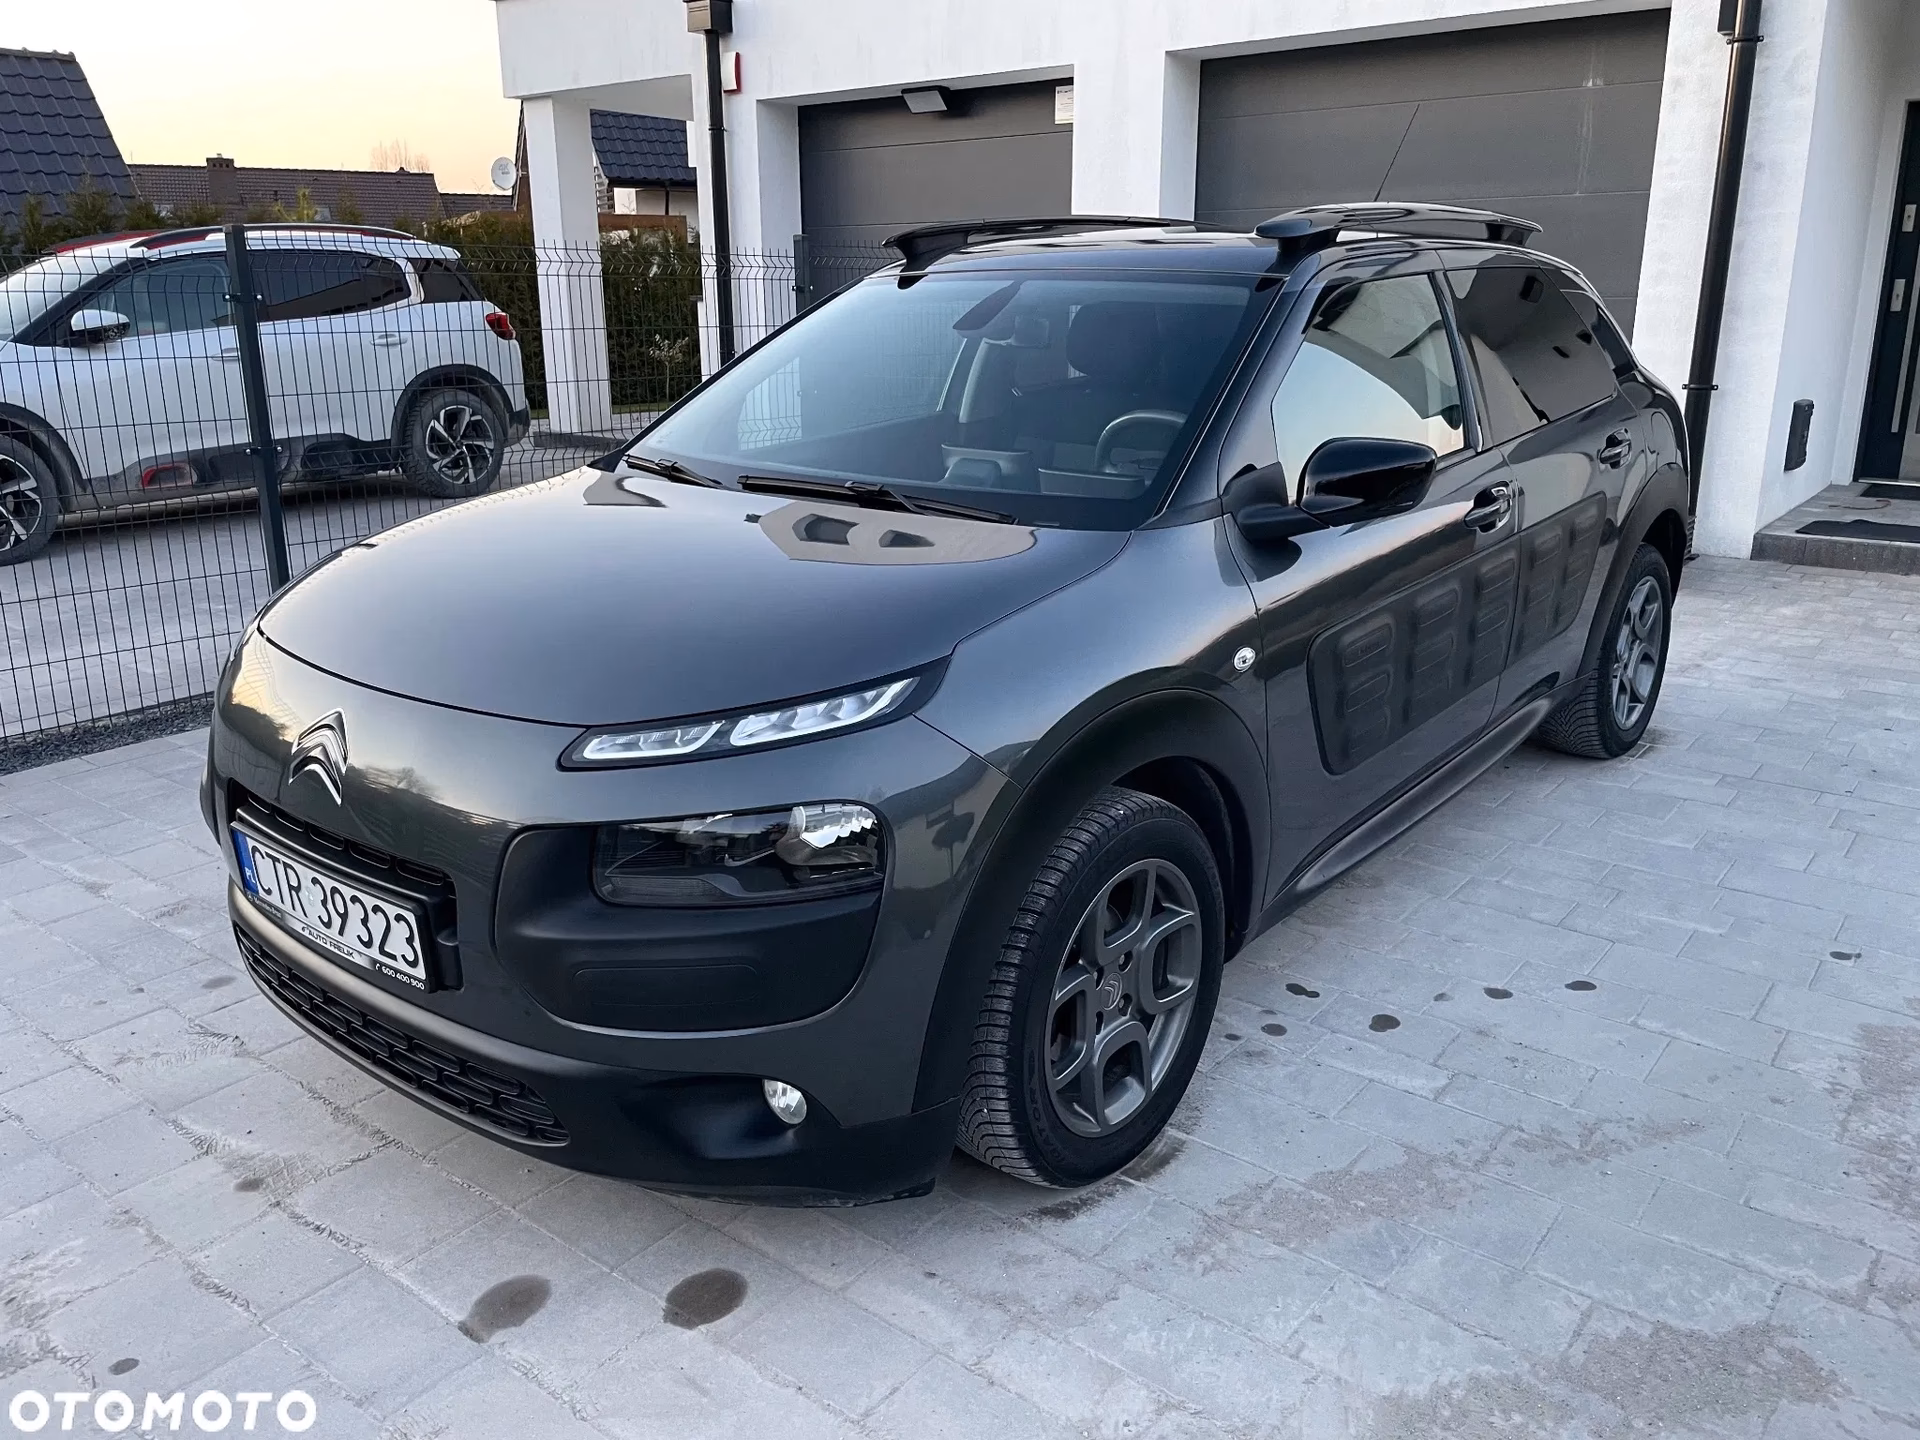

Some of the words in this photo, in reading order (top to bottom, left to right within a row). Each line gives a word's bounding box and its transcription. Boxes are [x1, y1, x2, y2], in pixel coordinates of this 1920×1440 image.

[244, 866, 256, 883] PL
[251, 845, 309, 918] CTR
[311, 877, 419, 968] 39323
[309, 931, 327, 945] AUTO
[382, 966, 396, 978] 600
[396, 973, 410, 984] 400
[410, 978, 425, 990] 900
